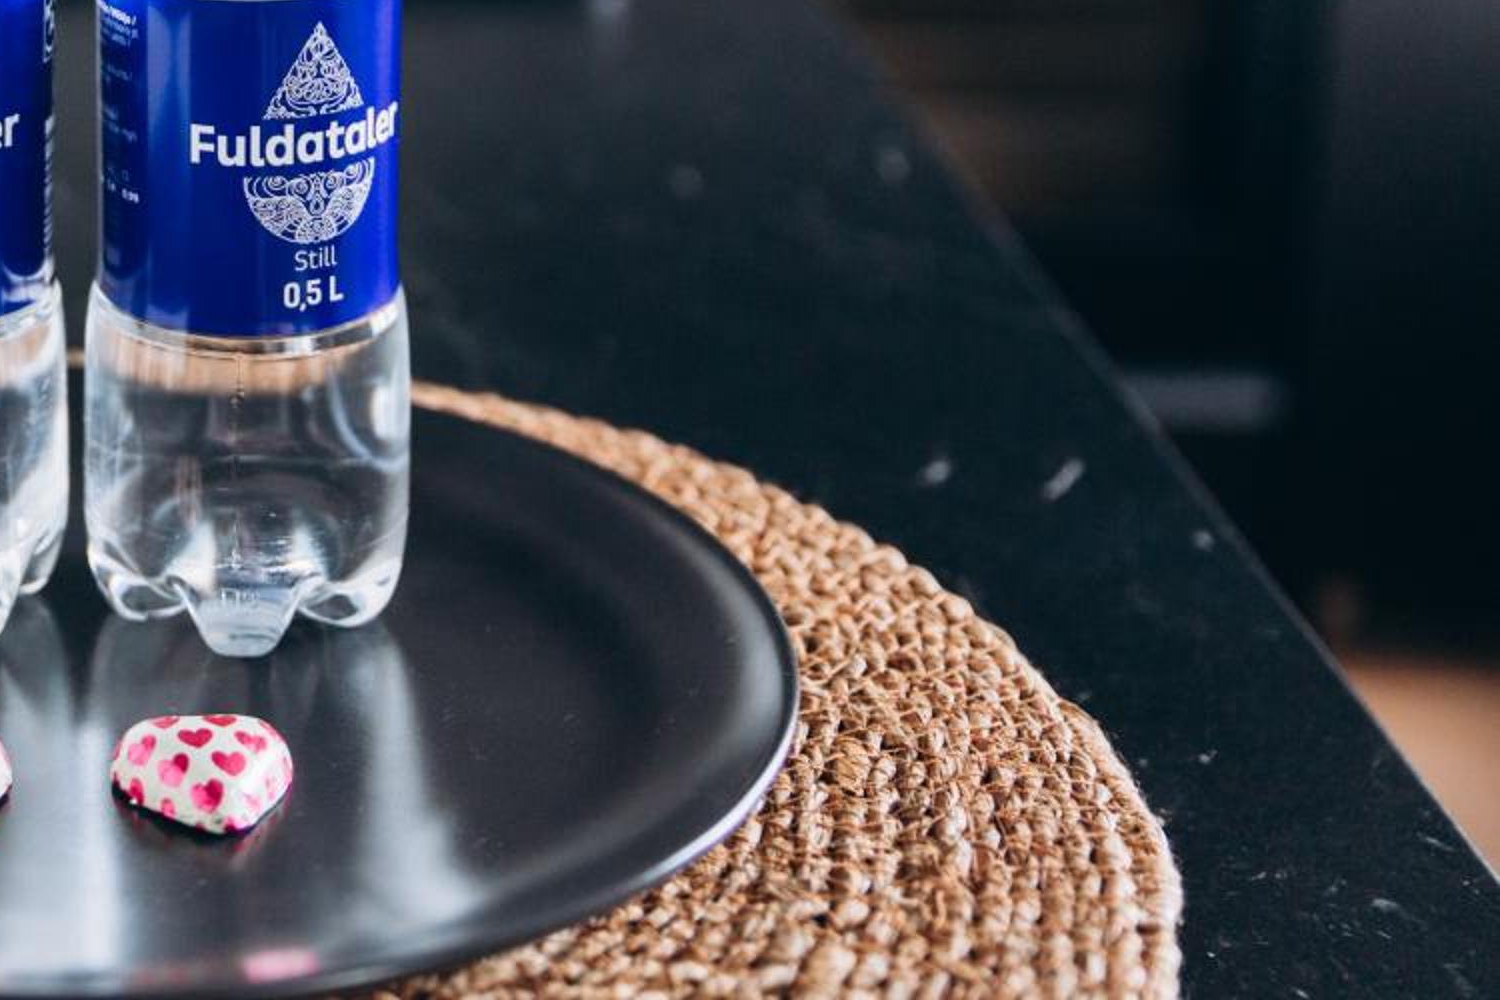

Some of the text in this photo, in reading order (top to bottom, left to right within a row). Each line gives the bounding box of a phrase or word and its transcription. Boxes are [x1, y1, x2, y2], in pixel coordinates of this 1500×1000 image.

[190, 100, 398, 167] Fuldataler
[295, 245, 337, 271] Still
[283, 278, 344, 312] 0,5 L
